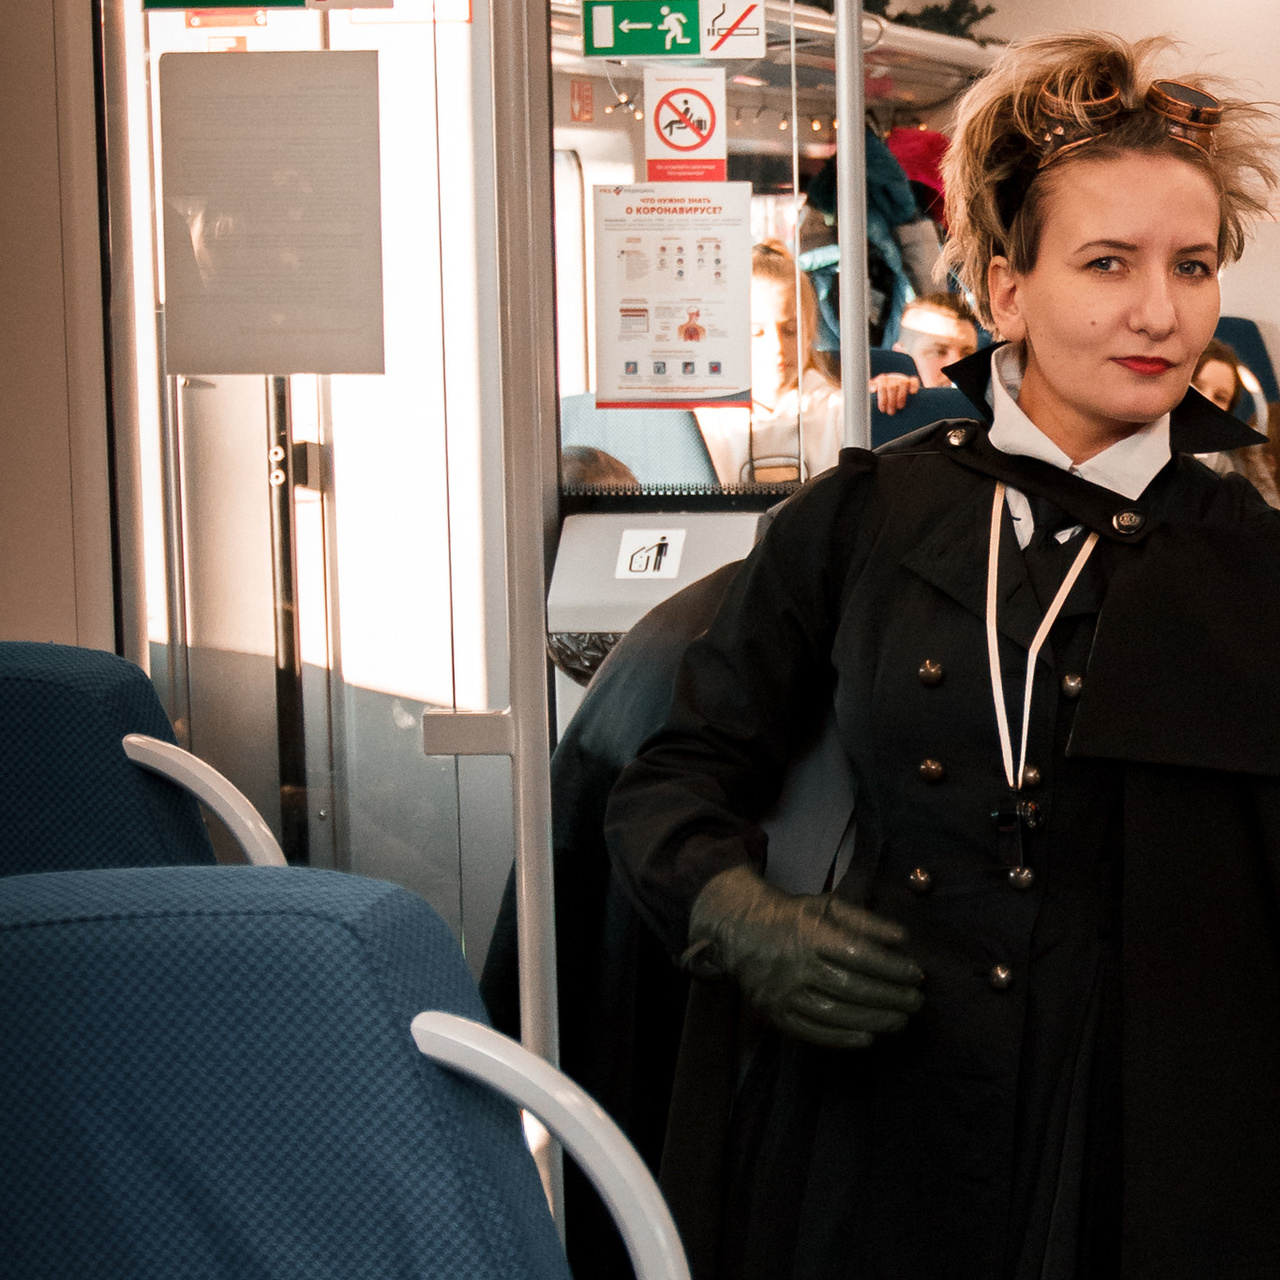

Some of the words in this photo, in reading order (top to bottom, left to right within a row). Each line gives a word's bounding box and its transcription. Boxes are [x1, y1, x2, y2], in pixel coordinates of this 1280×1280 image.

[639, 197, 655, 205] ЧТО
[657, 197, 686, 205] НУЖНО
[688, 197, 712, 205] ЗНАТЬ
[625, 206, 633, 216] О
[635, 206, 723, 216] КОРОНАВИРУСЕ?
